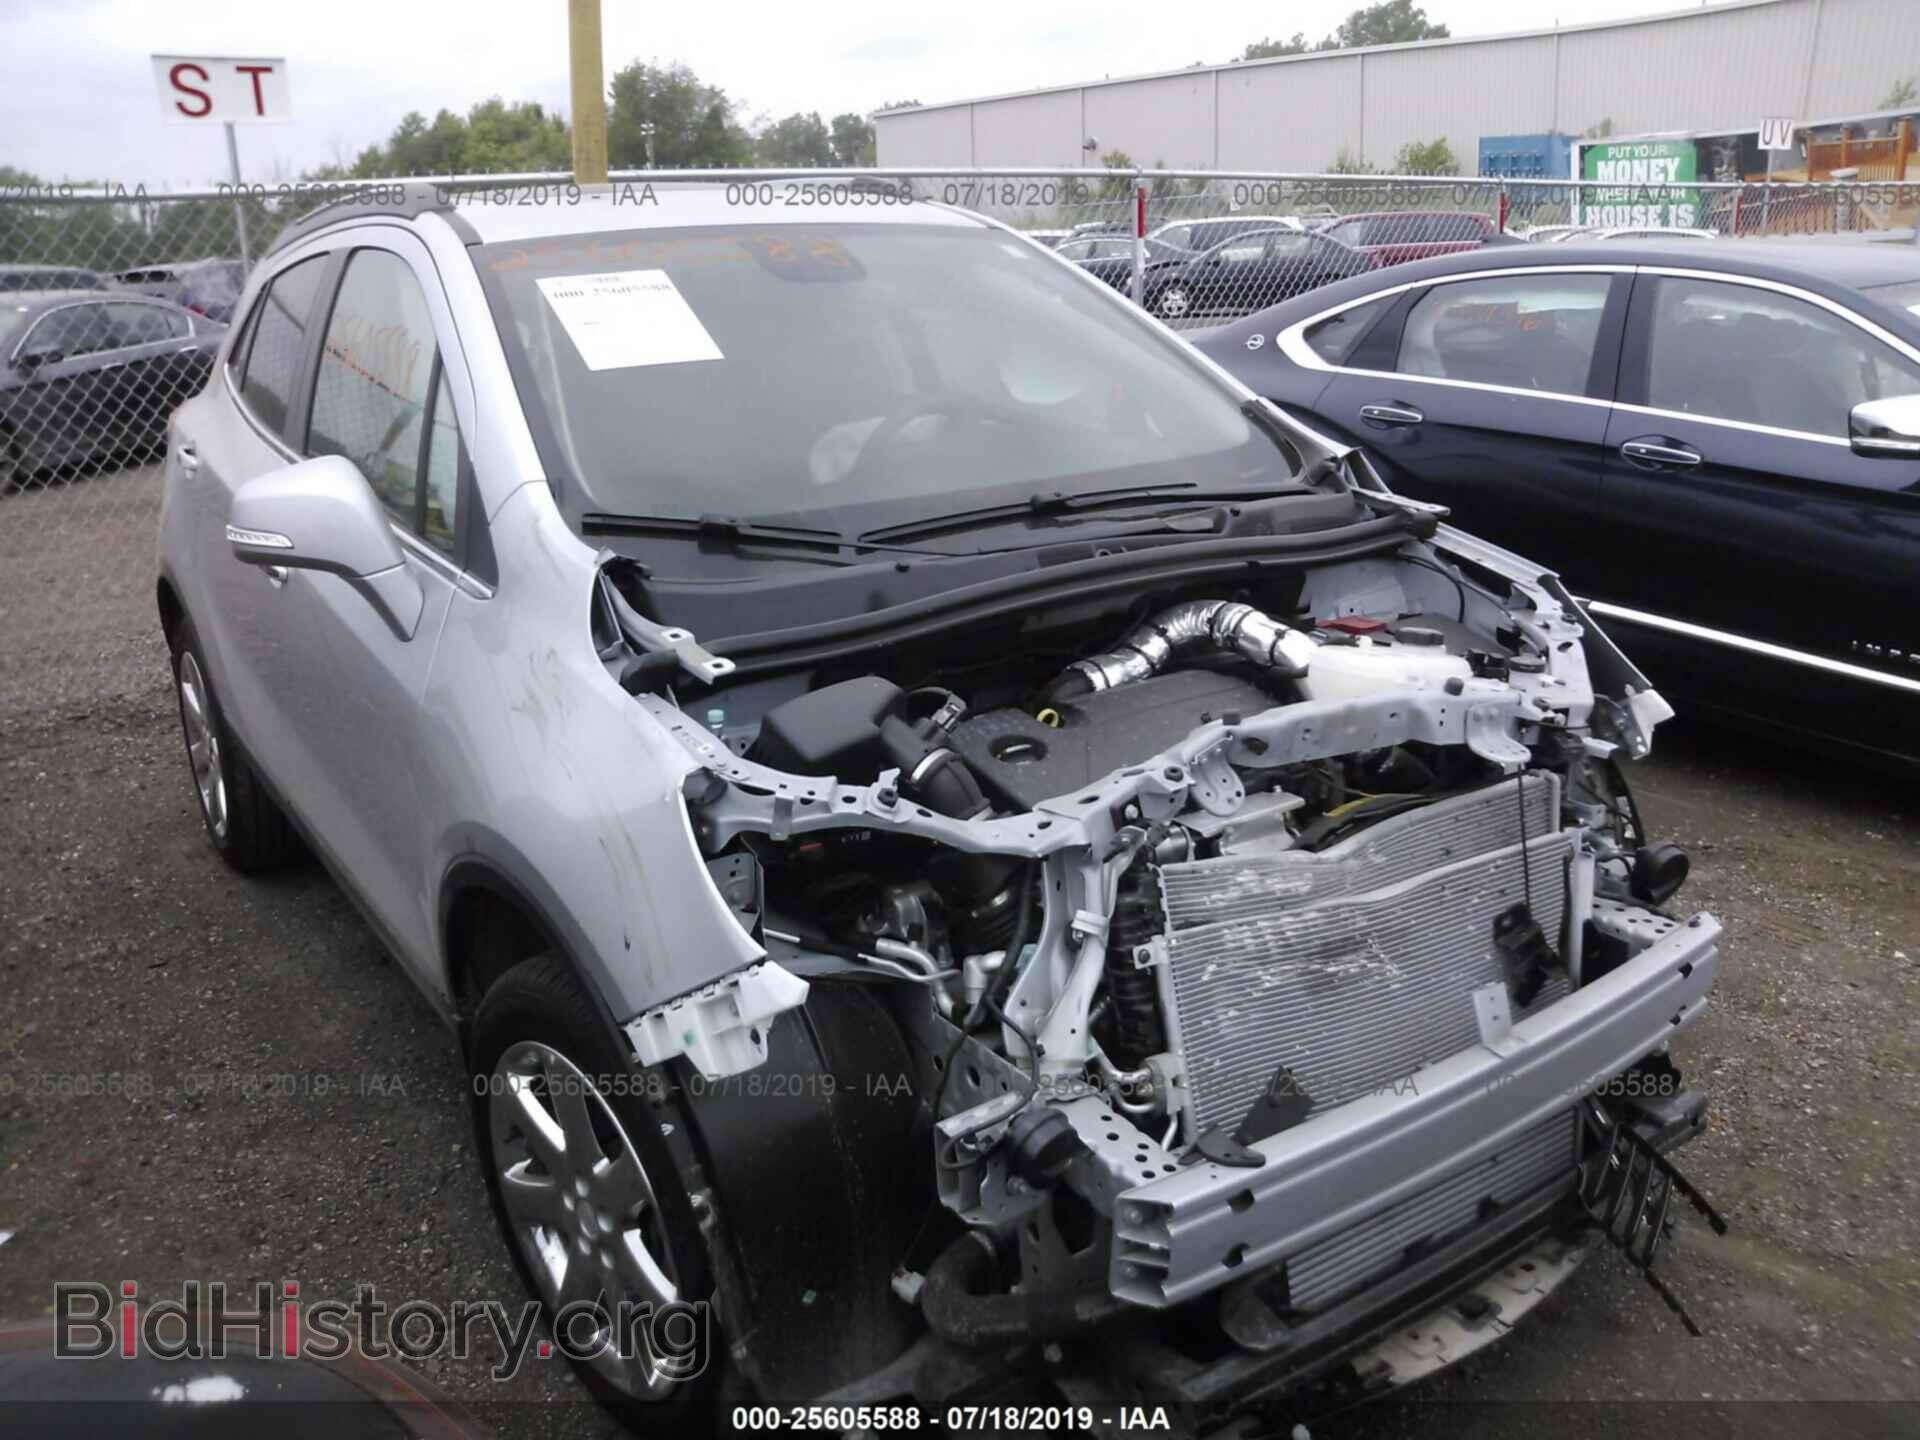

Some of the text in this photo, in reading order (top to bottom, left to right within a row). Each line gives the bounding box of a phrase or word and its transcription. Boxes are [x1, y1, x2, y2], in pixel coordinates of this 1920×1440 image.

[1608, 144, 1668, 159] PUT YOUR
[1597, 157, 1680, 182] MONEY
[1586, 203, 1695, 227] HOUSE IS
